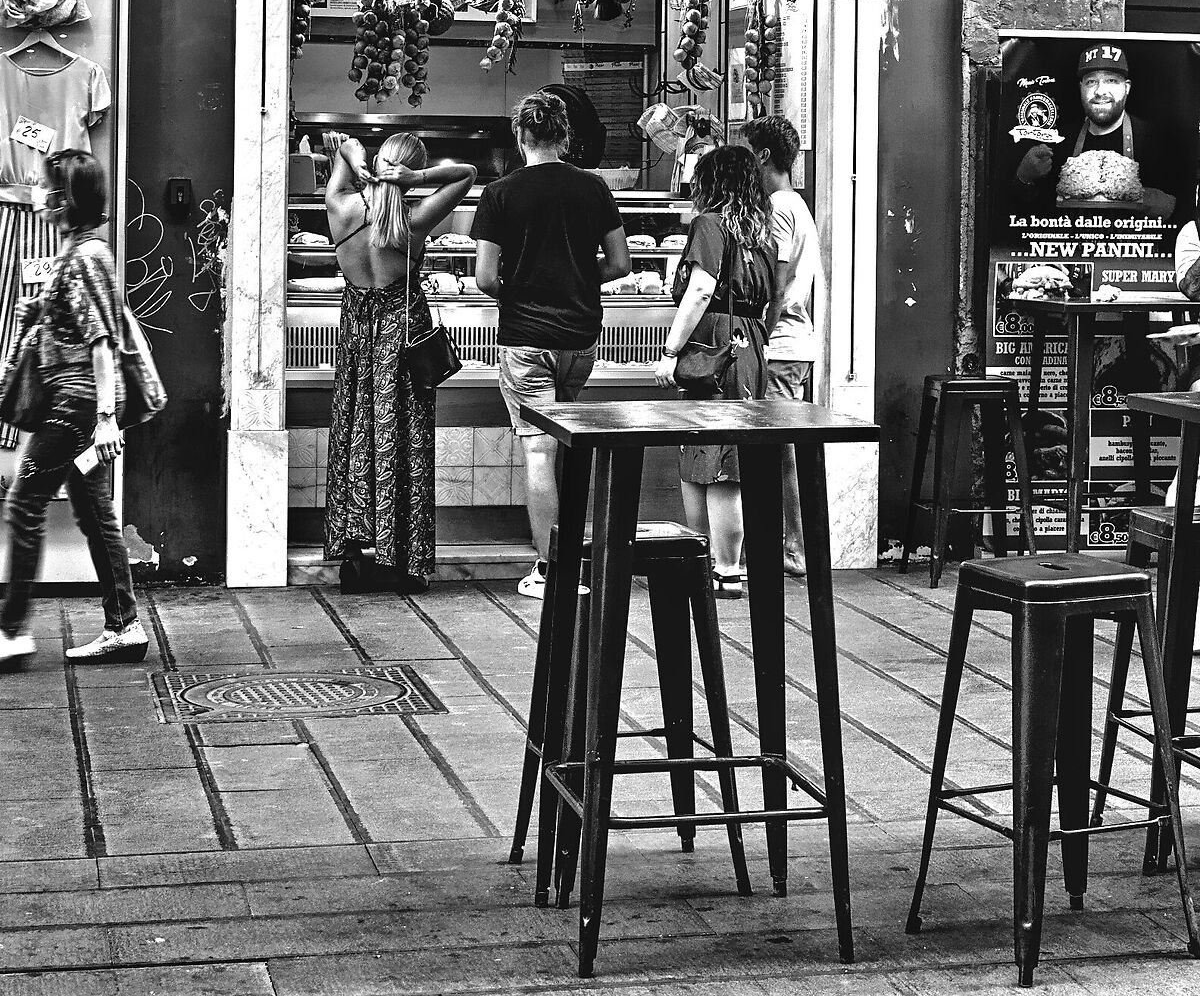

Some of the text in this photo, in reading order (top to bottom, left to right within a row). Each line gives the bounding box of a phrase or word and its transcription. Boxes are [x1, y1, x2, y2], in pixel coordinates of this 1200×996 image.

[1101, 46, 1122, 62] 17
[1009, 215, 1177, 231] La bontà dalle origini...
[1102, 270, 1137, 282] SUPER
[996, 342, 1016, 354] BIG
